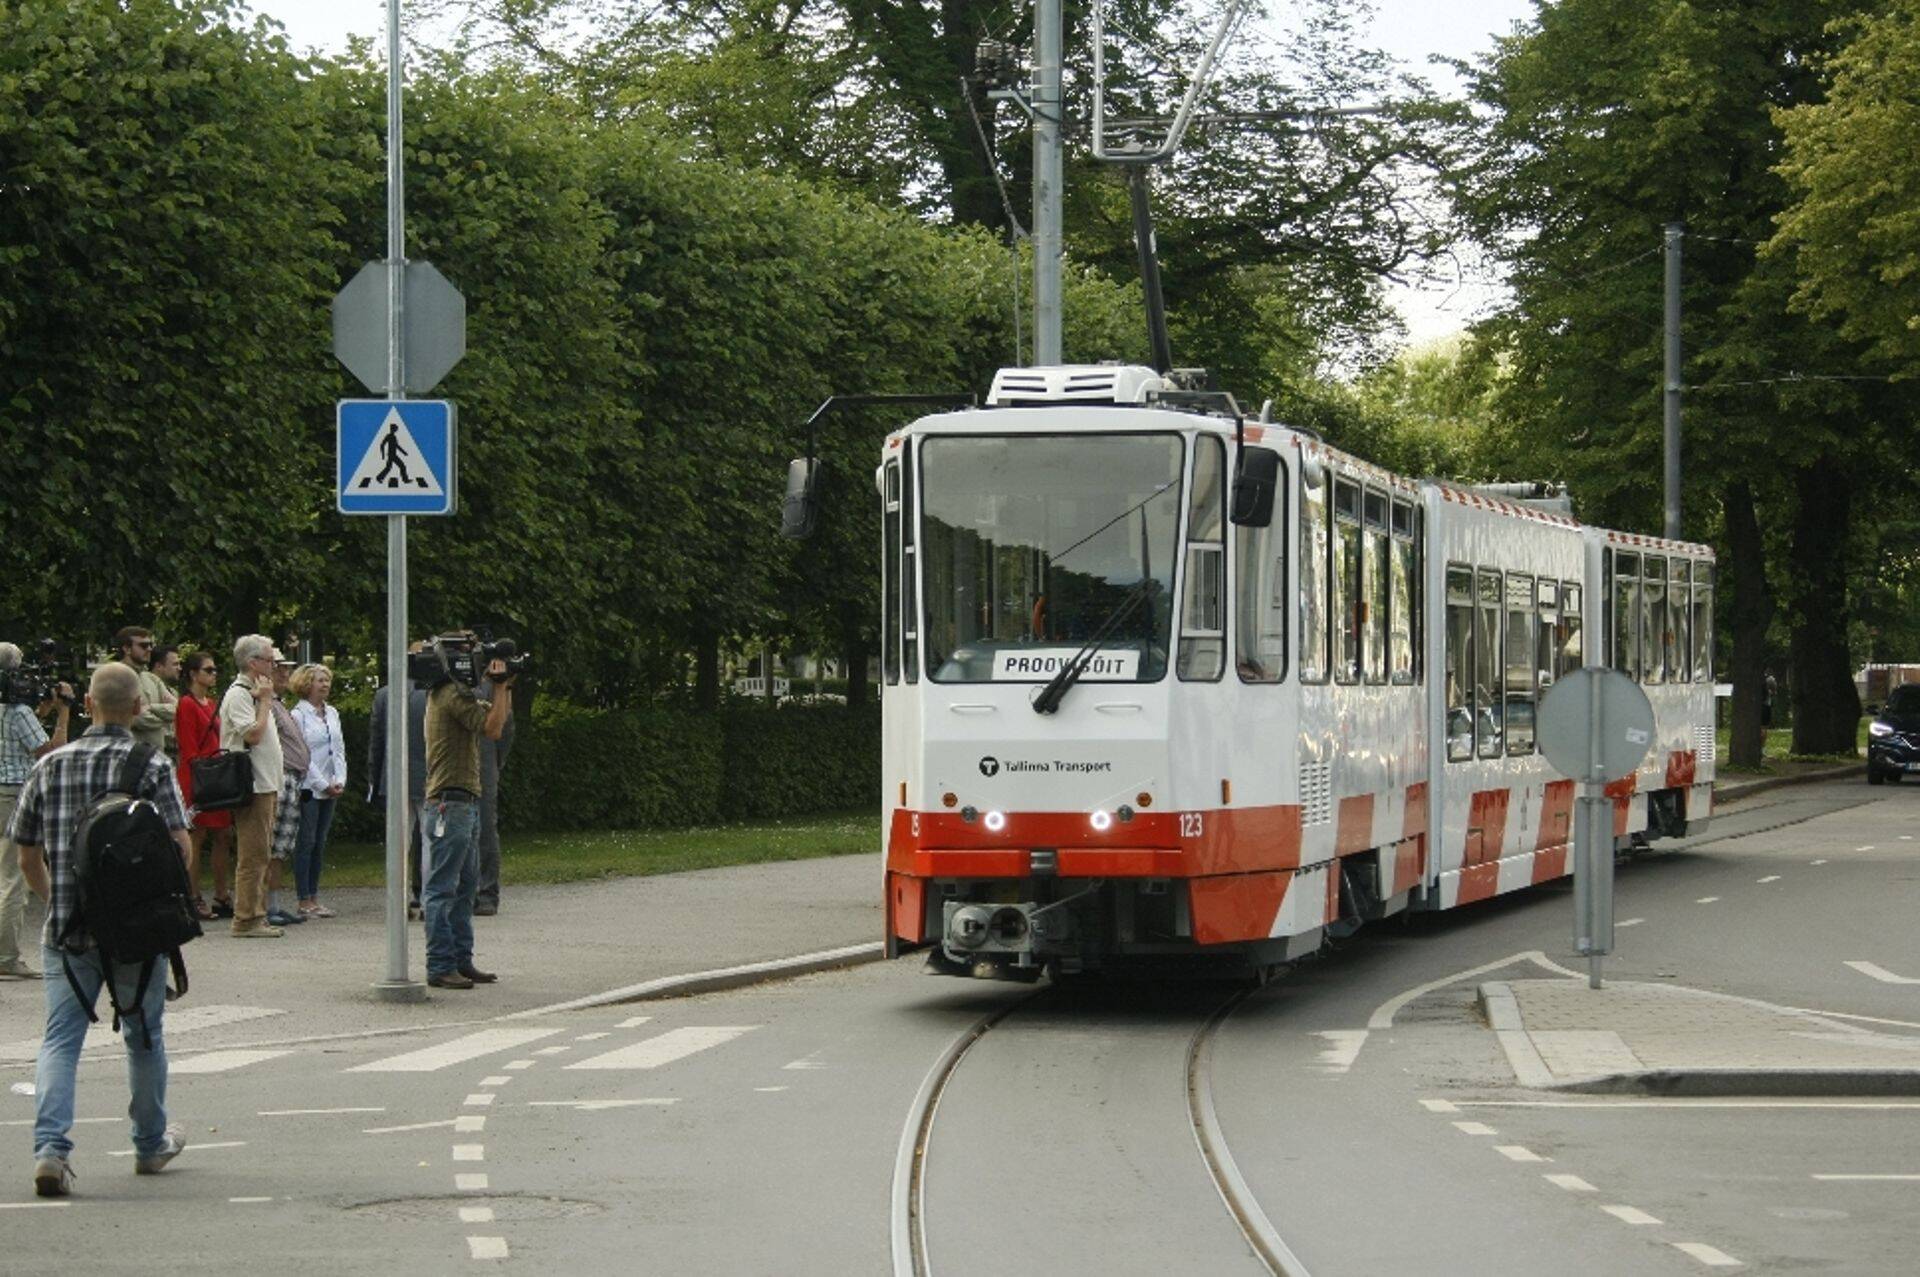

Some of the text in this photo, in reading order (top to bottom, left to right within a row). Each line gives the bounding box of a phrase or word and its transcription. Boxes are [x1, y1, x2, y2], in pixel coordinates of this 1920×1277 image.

[1004, 760, 1050, 772] Tallinna
[1053, 760, 1112, 774] Transport
[1179, 813, 1203, 838] 123
